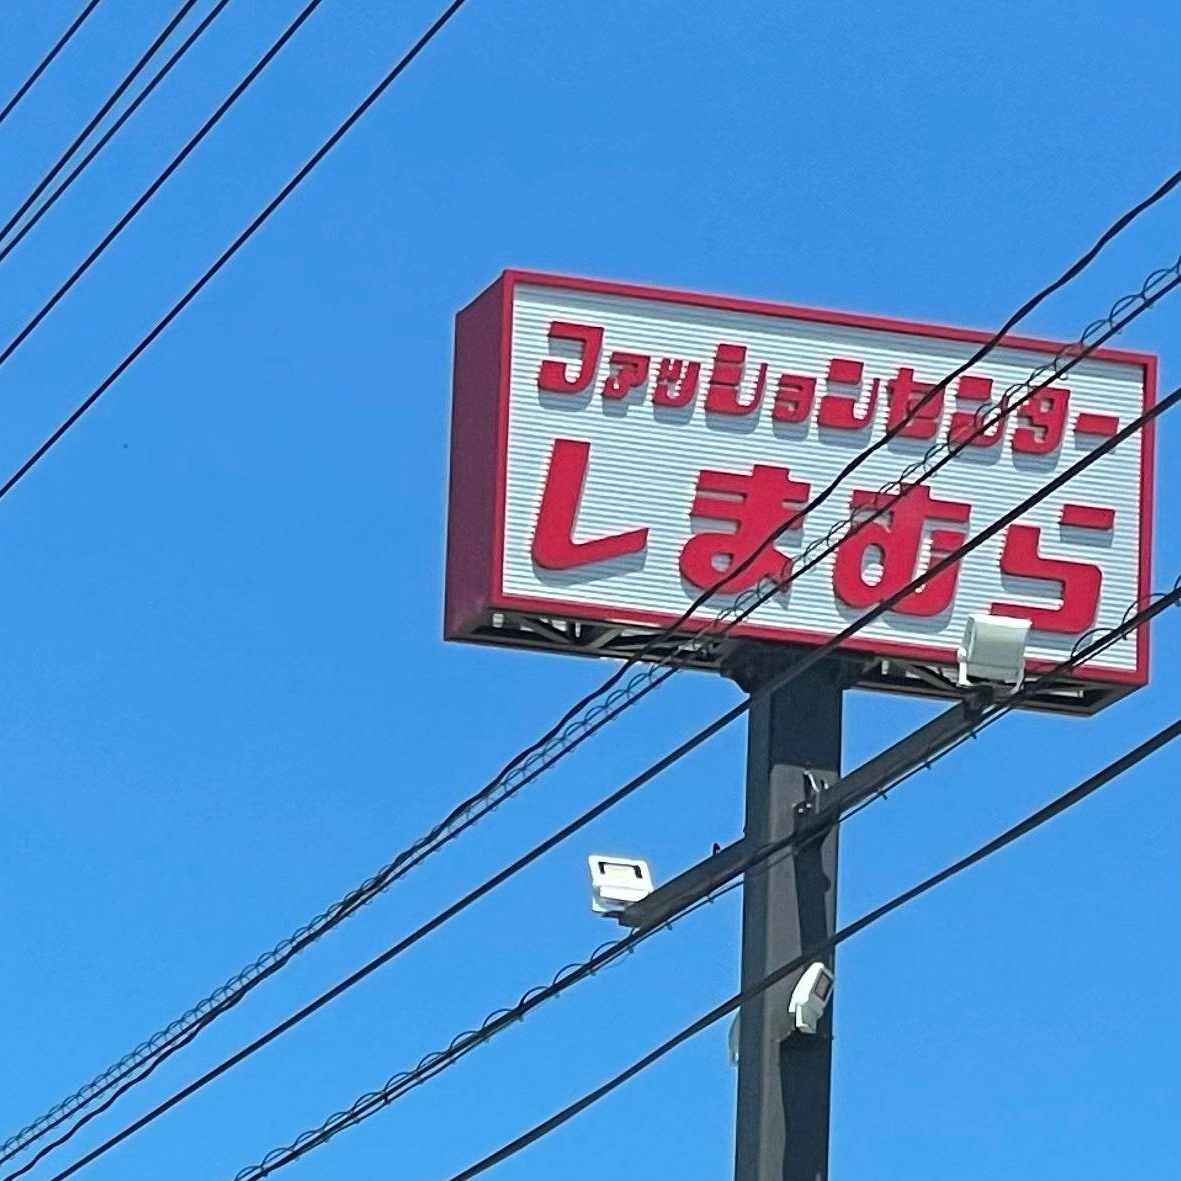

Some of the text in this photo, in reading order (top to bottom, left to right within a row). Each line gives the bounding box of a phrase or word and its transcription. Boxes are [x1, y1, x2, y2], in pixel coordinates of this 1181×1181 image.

[537, 320, 1119, 456] ファッションセンター
[531, 437, 1116, 635] しまむら
